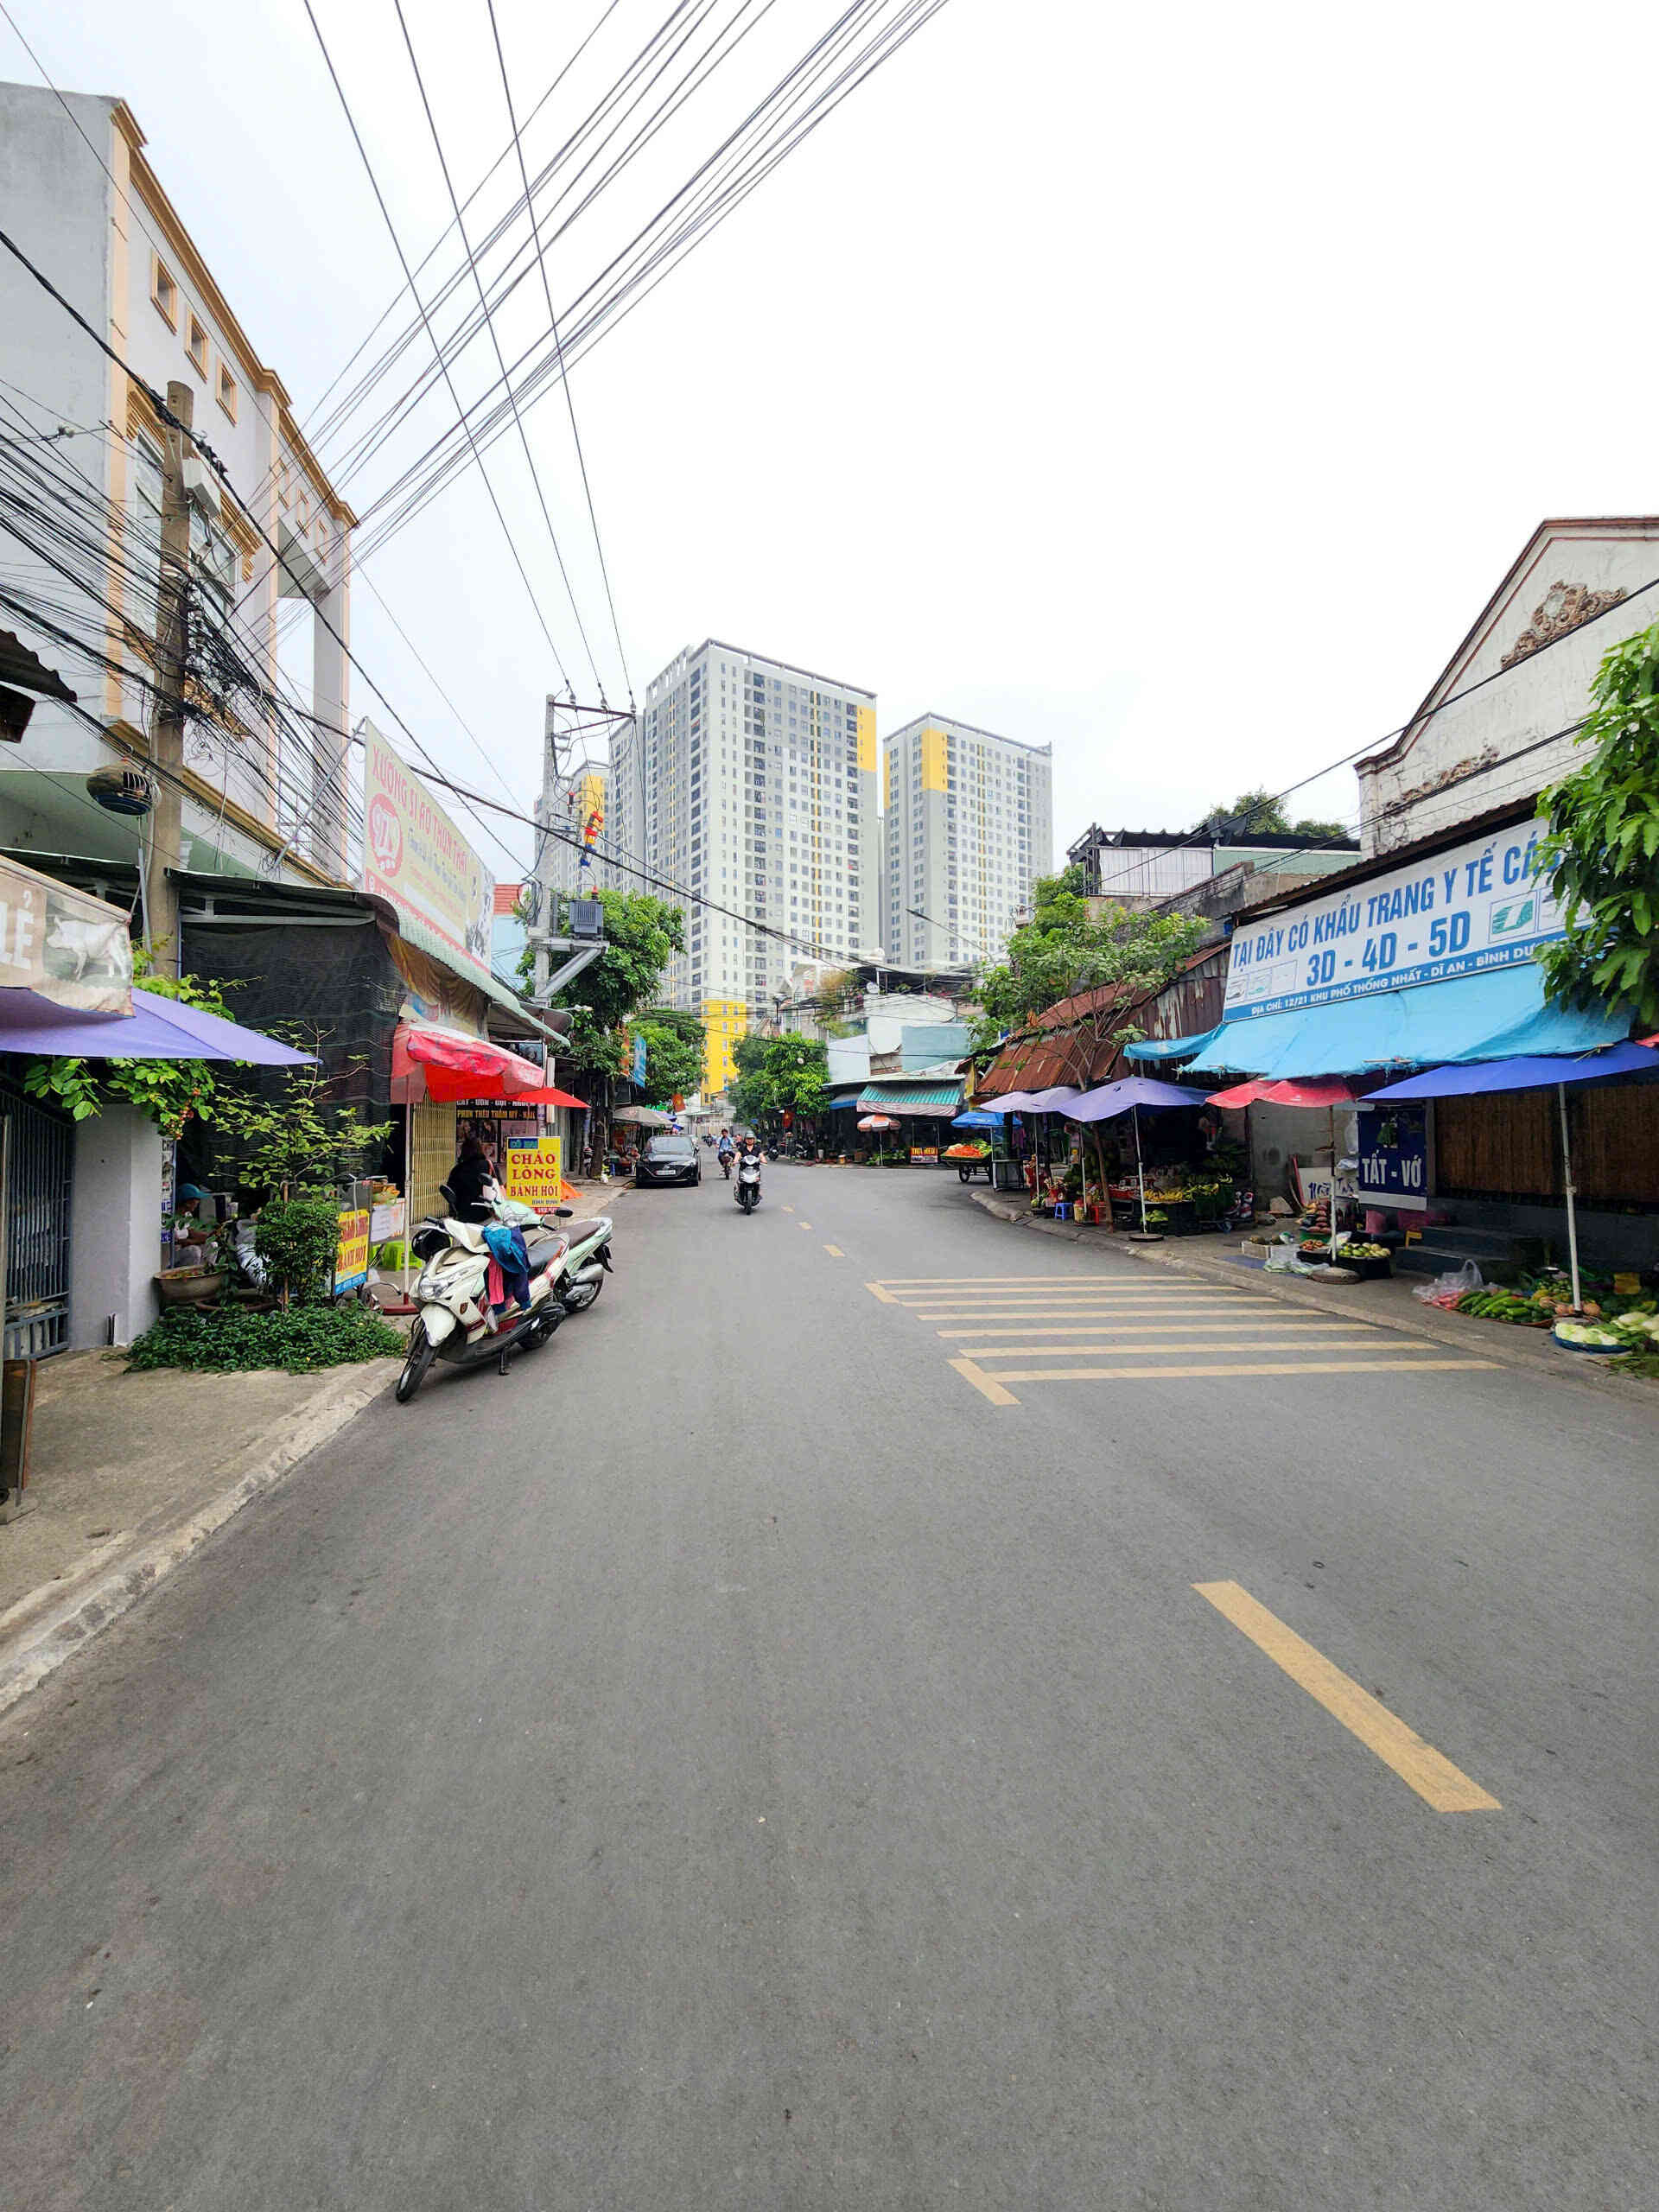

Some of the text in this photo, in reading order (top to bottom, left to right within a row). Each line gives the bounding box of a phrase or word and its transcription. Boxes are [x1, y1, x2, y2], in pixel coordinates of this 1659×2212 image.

[1233, 939, 1253, 972] TẠI
[1256, 926, 1286, 962] ĐÂY
[1288, 913, 1309, 953] CÓ
[1313, 893, 1362, 945] KHẨU
[1368, 877, 1435, 928] TRANG
[1444, 868, 1459, 905] Y
[1465, 842, 1497, 898] TẾ
[1306, 949, 1337, 987] 3D
[1362, 931, 1397, 973] 4D
[1428, 911, 1471, 958] 5D
[1310, 991, 1328, 1002] KHU
[1331, 983, 1352, 999] PHỐ
[1354, 974, 1389, 994] THỐNG
[1391, 967, 1422, 985] NHẤT
[1431, 962, 1445, 976] DĨ
[1446, 960, 1465, 975] AN
[1476, 950, 1510, 968] BÌNH
[512, 1150, 556, 1165] CHÁO
[512, 1166, 557, 1180] LÒNG
[1362, 1149, 1388, 1185] TẤT
[1402, 1154, 1422, 1189] VỚ
[511, 1182, 537, 1197] BÁNH
